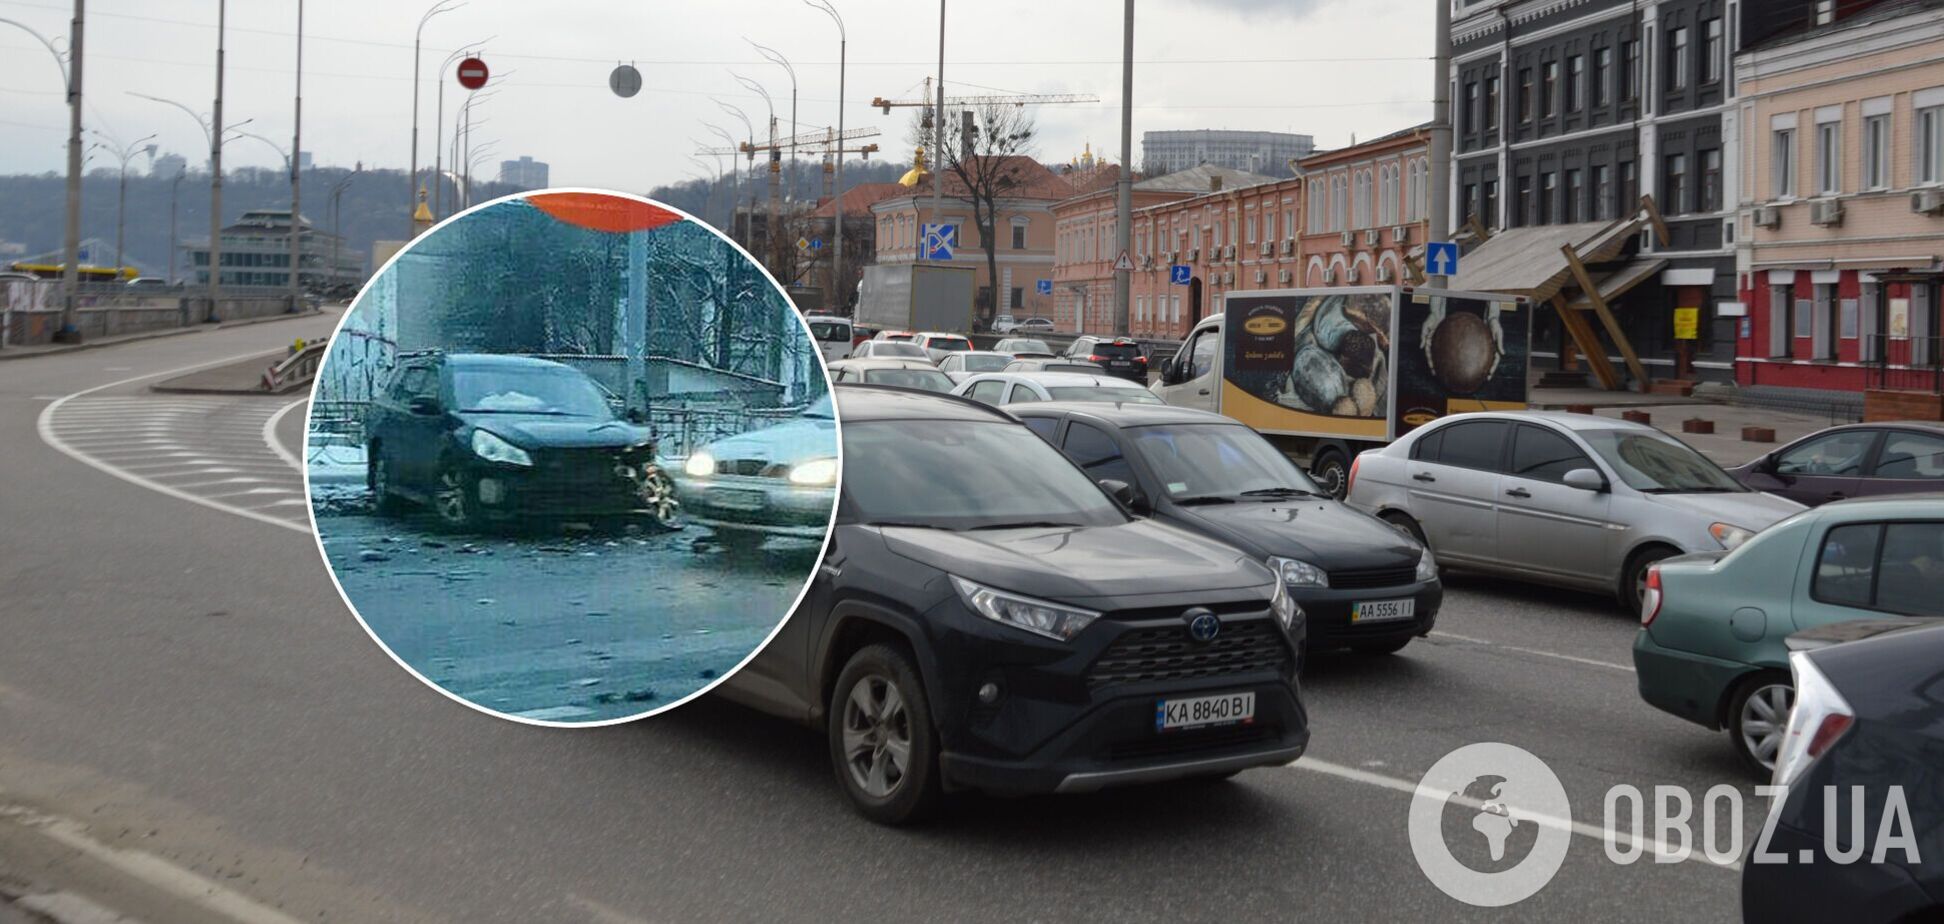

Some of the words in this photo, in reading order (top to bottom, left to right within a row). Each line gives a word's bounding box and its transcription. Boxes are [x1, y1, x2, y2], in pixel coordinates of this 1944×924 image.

[1360, 603, 1374, 619] AA
[1376, 602, 1398, 617] 5556
[1166, 702, 1189, 724] KA
[1192, 698, 1229, 721] 8840
[1232, 695, 1251, 717] BI
